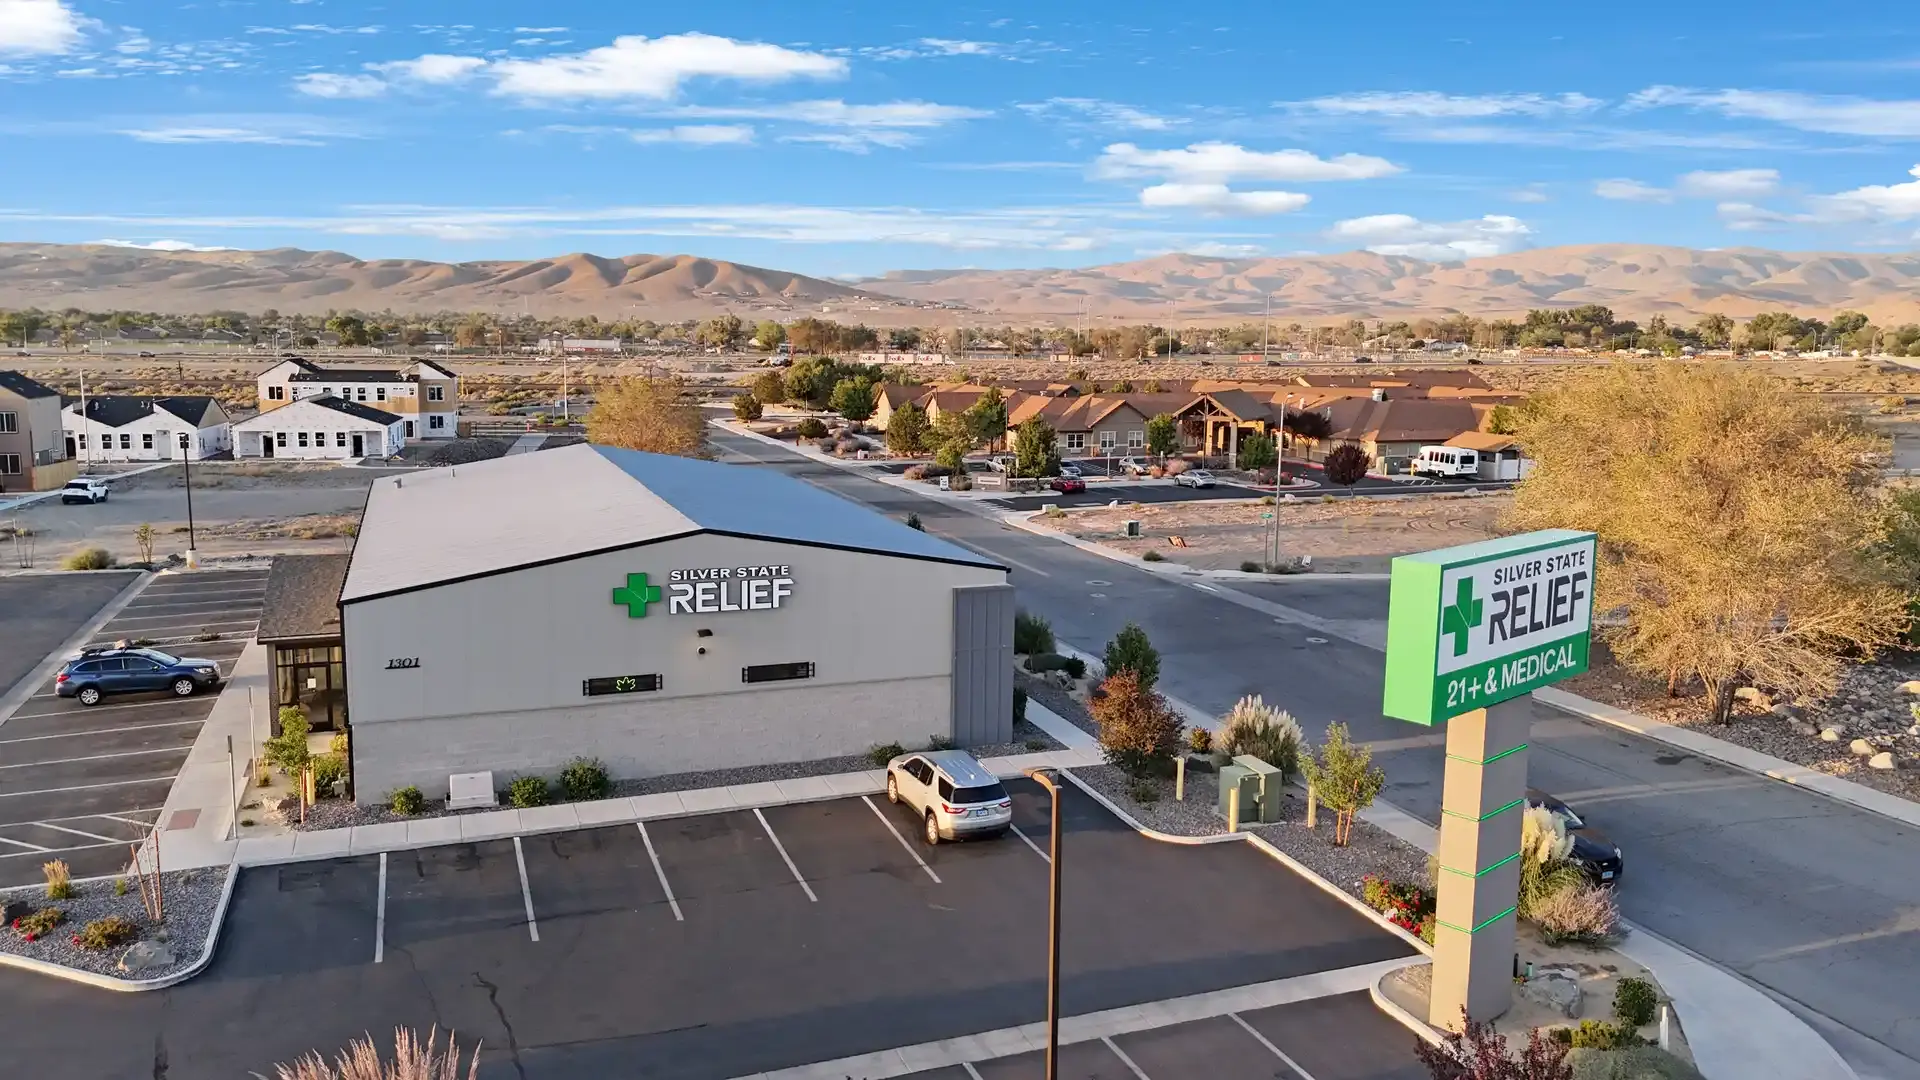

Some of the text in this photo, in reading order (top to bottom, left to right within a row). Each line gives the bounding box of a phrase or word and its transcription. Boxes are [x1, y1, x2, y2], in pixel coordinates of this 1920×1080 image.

[670, 565, 789, 581] SILVER STATE
[1494, 550, 1586, 586] SILVER STATE
[669, 578, 794, 614] RELIEF
[1488, 570, 1588, 645] RELIEF
[386, 657, 420, 669] 1301
[1446, 643, 1577, 708] 21+ & MEDICAL
